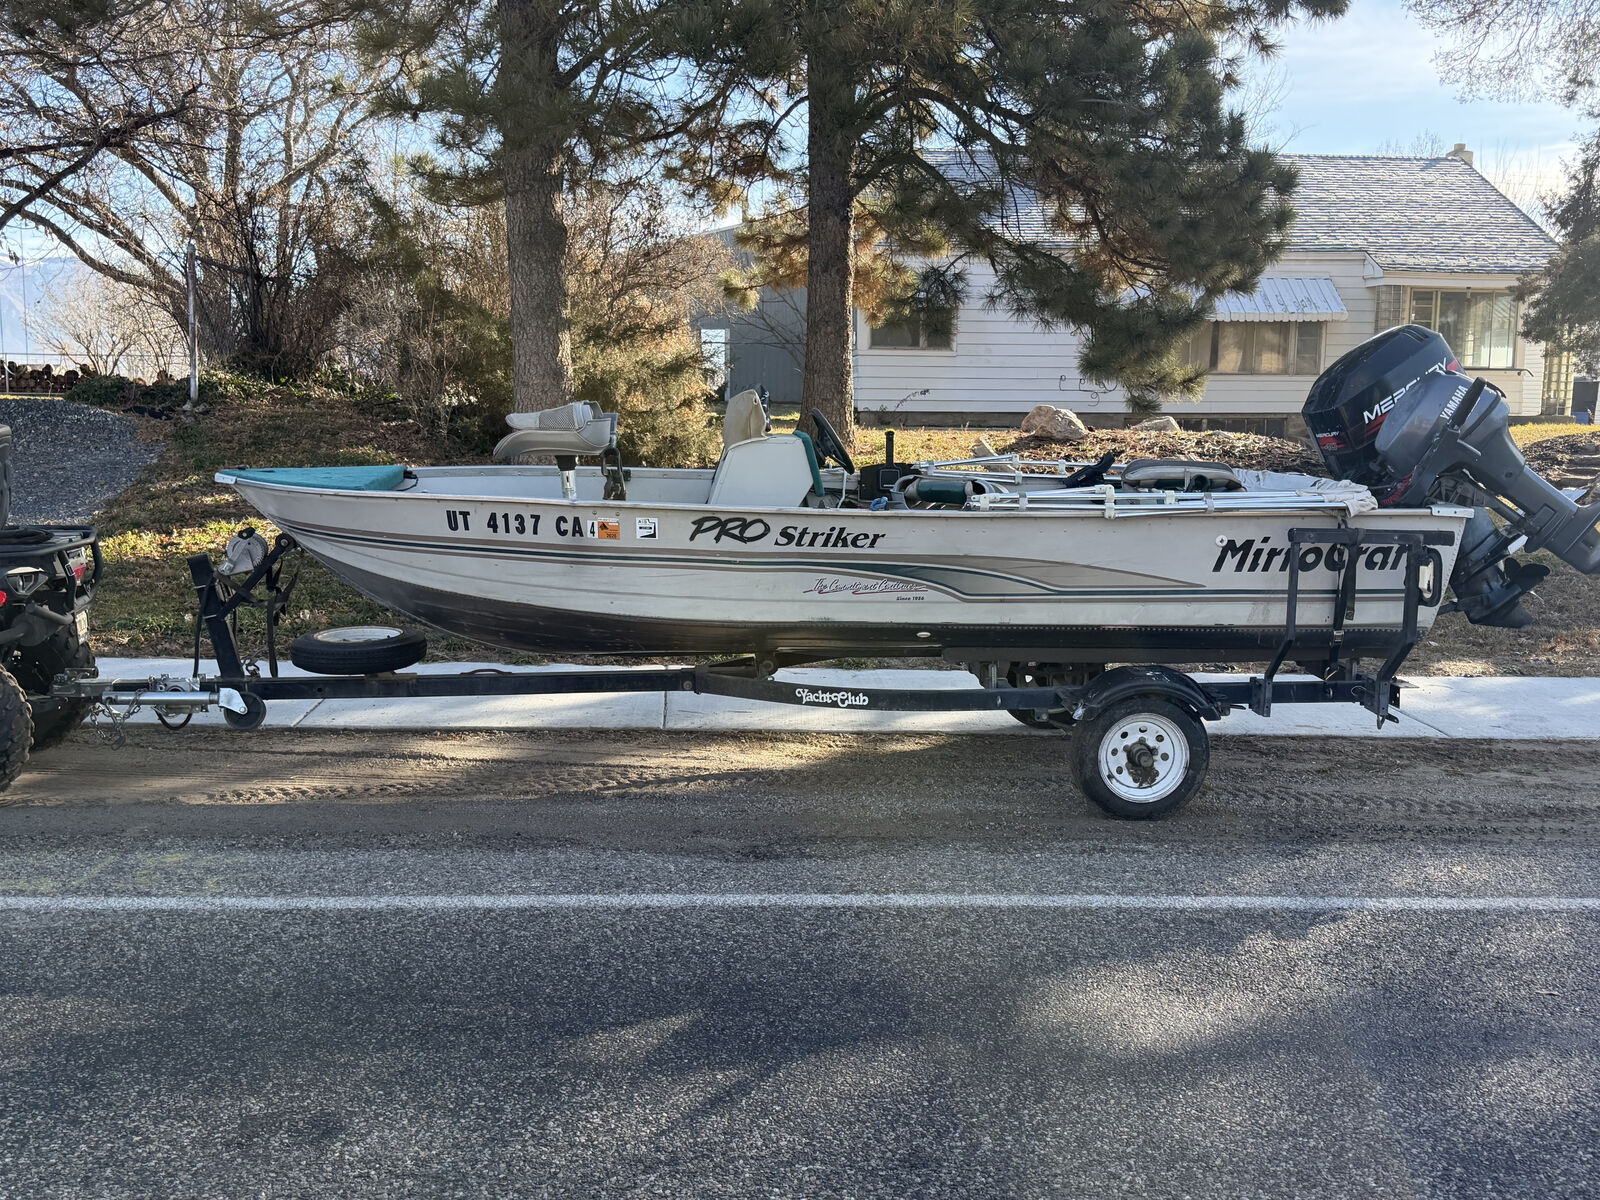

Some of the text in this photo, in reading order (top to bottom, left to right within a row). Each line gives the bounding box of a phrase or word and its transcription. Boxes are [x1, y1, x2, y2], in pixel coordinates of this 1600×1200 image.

[1362, 357, 1447, 424] MERY
[1440, 385, 1469, 420] YAMAHA
[446, 510, 584, 537] UT 4137 CA
[590, 522, 595, 537] 4
[689, 516, 887, 548] PRO Striker
[1212, 536, 1409, 573] MirroCaf
[813, 578, 828, 591] The
